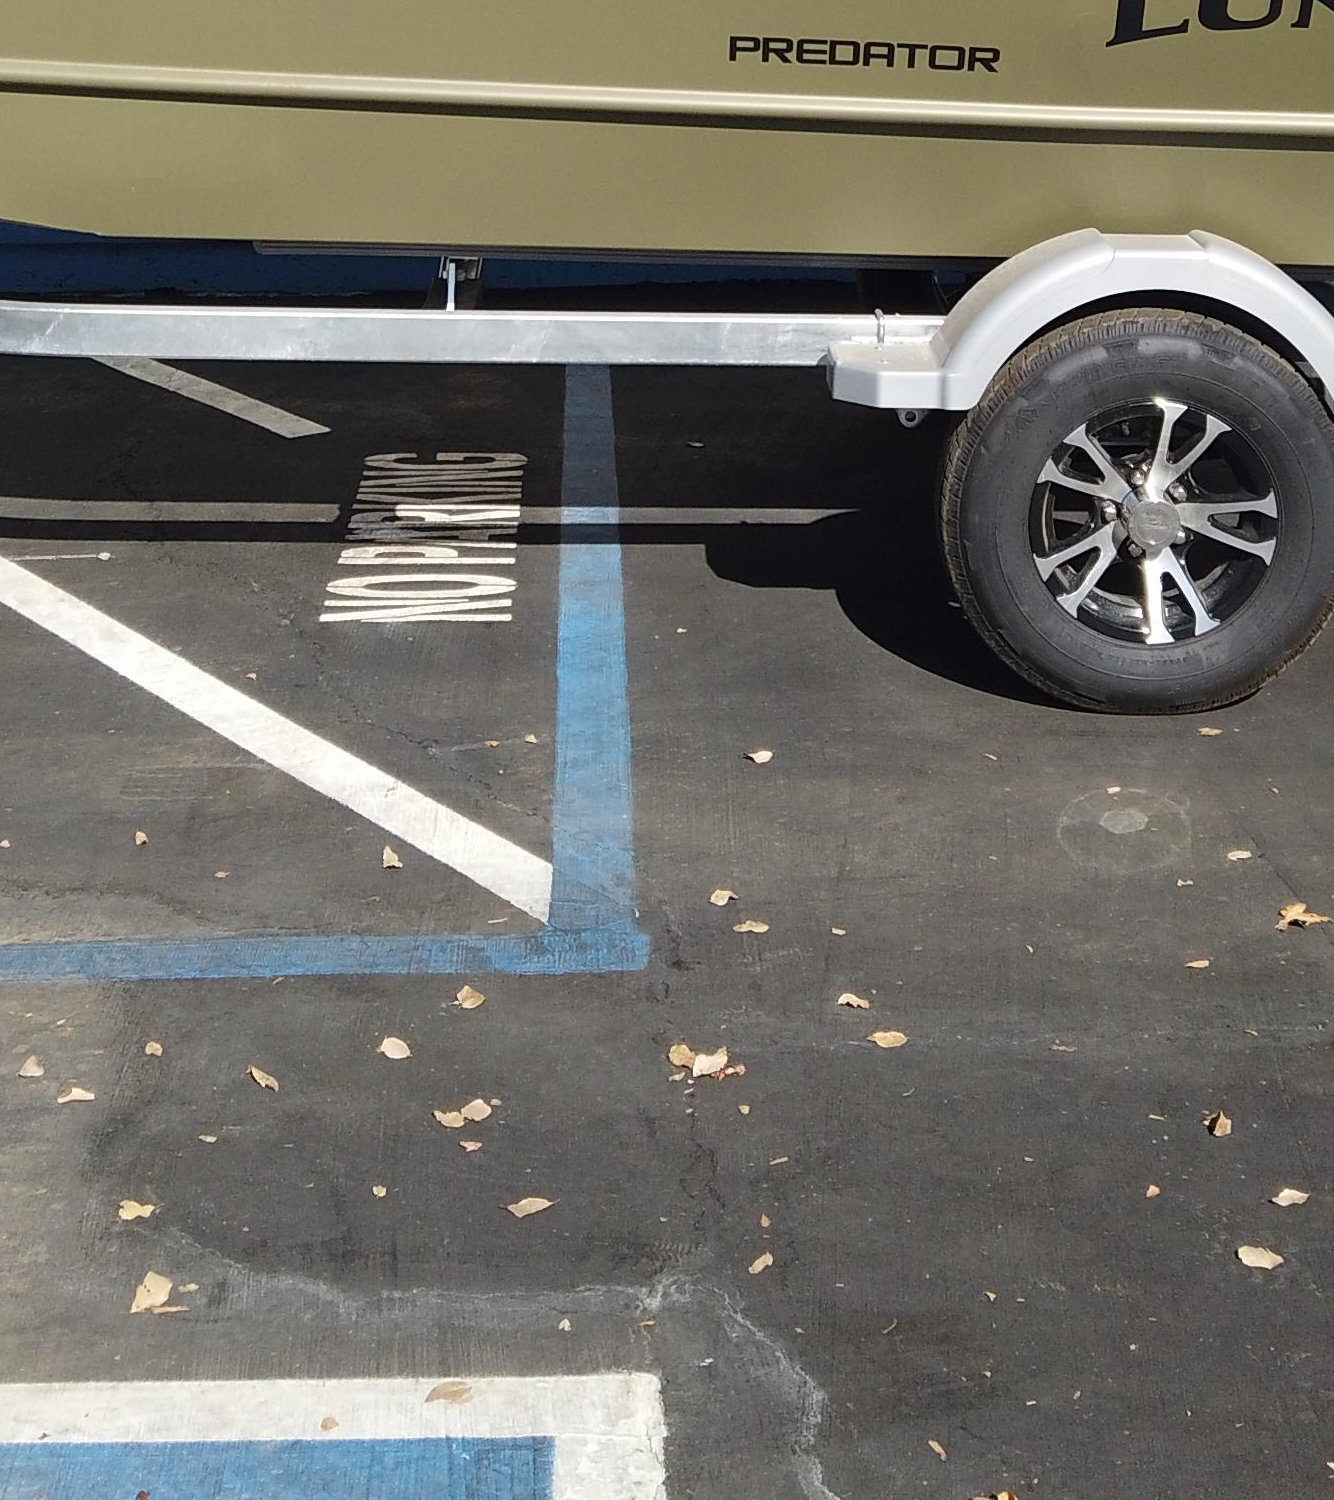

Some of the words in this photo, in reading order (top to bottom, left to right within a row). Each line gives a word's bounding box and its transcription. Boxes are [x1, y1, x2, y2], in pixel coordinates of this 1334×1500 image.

[728, 35, 1000, 73] PREDATOR
[337, 452, 529, 565] PARKING
[319, 574, 518, 623] NO
